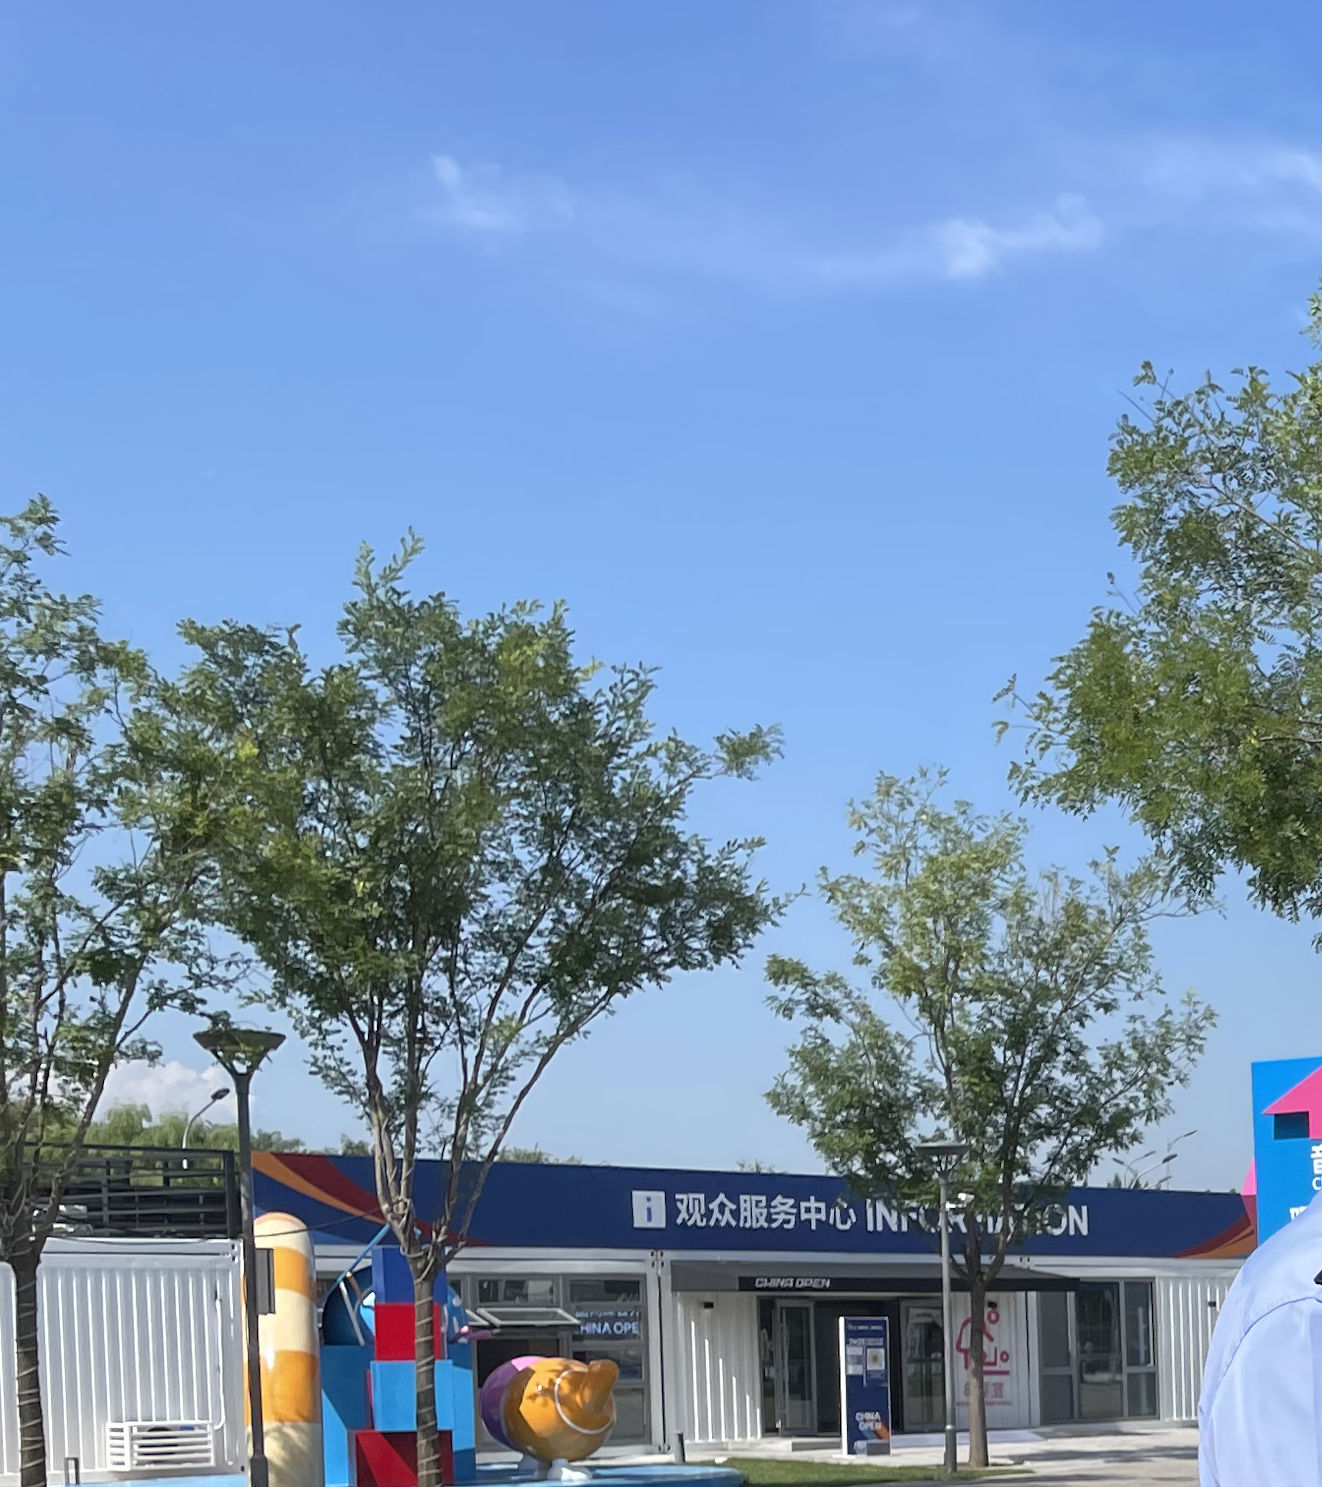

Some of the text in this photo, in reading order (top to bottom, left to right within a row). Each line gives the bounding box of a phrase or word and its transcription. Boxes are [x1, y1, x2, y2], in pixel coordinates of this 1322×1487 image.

[675, 1192, 857, 1231] 观众服务中心
[755, 1277, 831, 1289] CHINA OPEN
